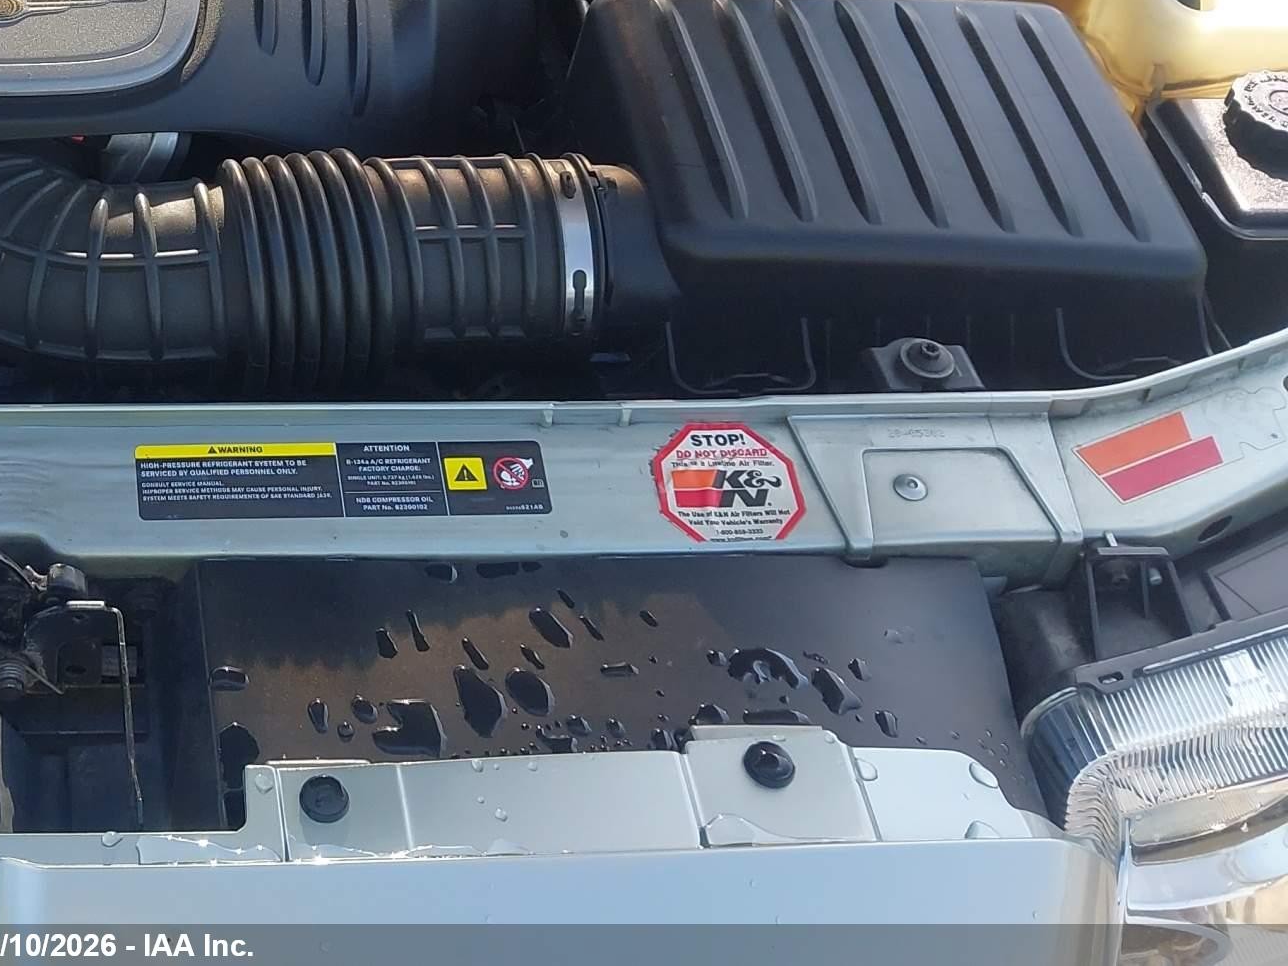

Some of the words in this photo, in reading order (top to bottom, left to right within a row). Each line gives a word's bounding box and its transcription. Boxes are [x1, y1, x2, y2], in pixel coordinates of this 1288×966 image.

[690, 433, 745, 447] STOP!
[218, 446, 263, 454] WARNING
[676, 450, 691, 459] DO
[695, 449, 716, 458] NOT
[719, 448, 767, 458] DISCARD
[140, 461, 201, 469] HIGH-PRESSURE
[202, 460, 253, 468] REFRIGERANT
